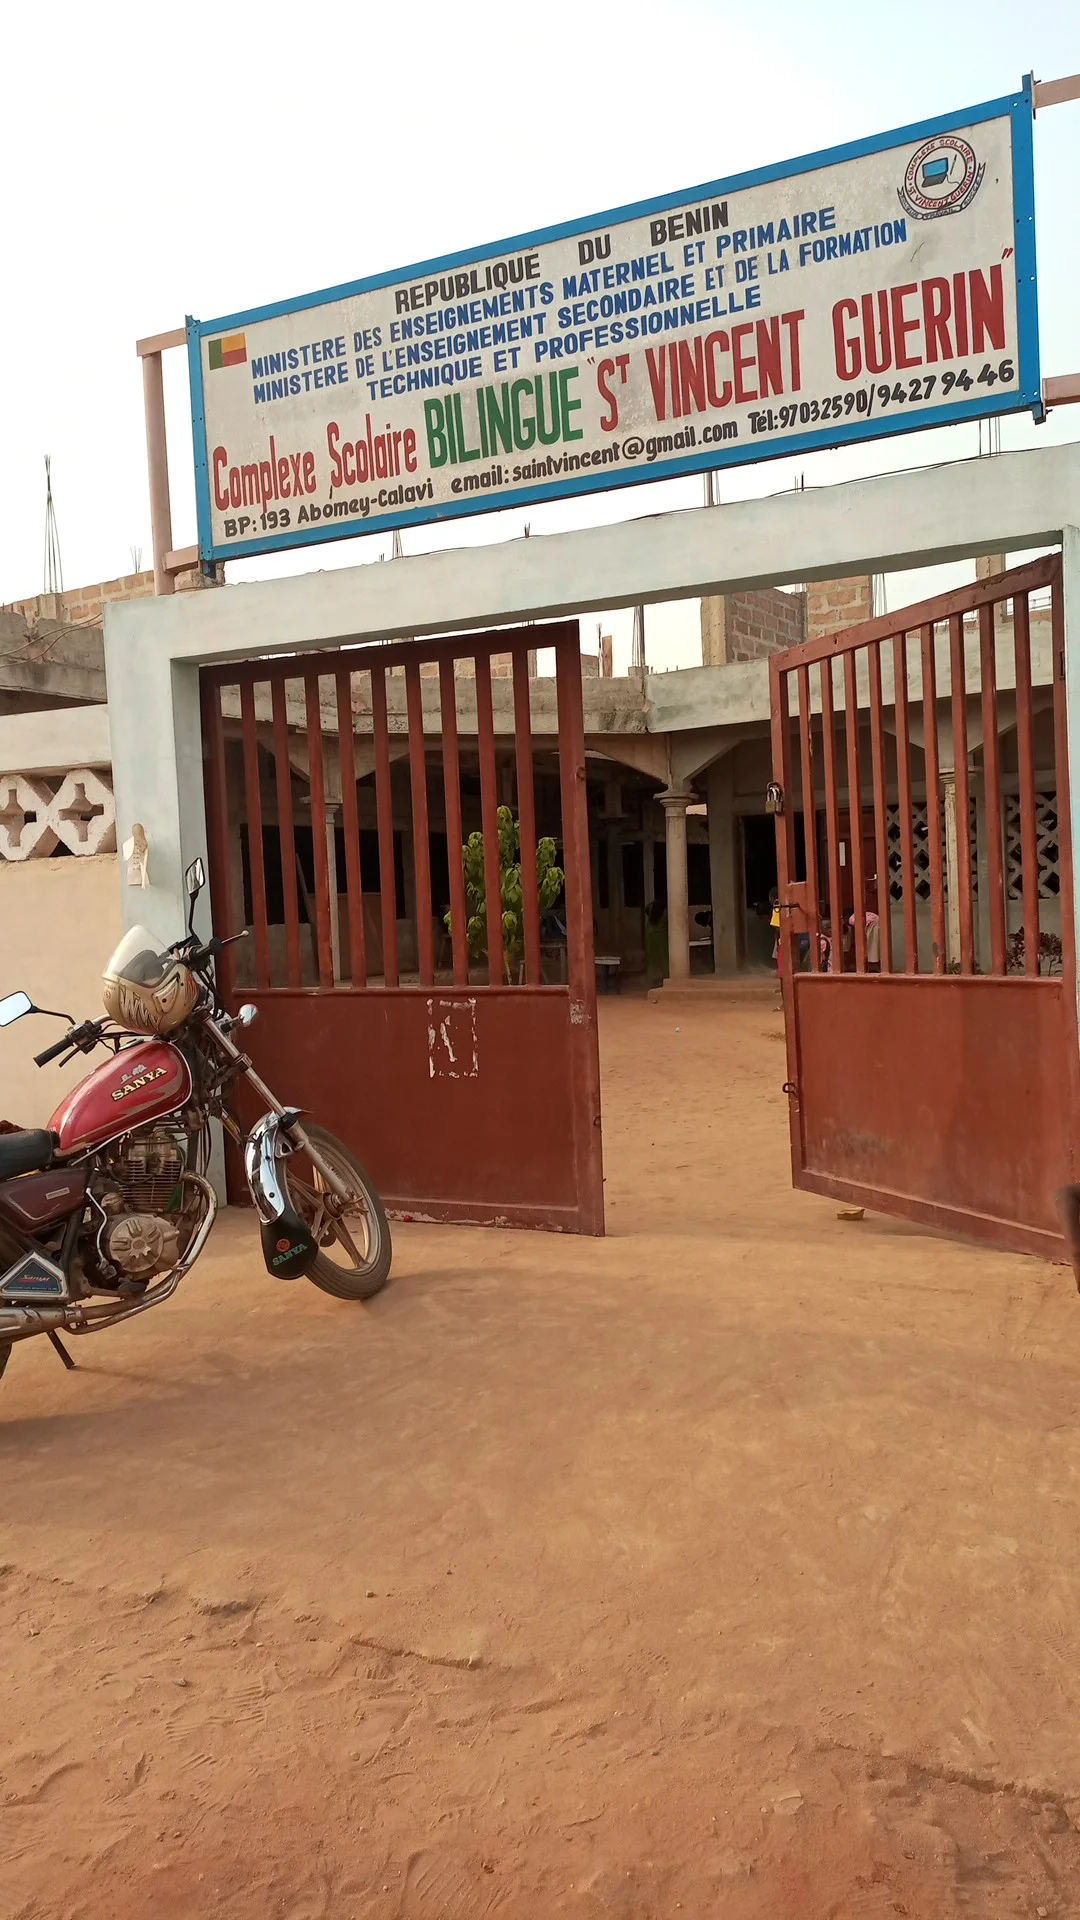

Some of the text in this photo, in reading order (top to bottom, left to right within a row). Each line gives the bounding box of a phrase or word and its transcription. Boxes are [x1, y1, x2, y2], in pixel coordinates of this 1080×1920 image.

[907, 139, 973, 181] COMPLEXE SCOLAIRE
[951, 170, 974, 201] GUERIN
[251, 206, 836, 379] MINISTERE DES ENSEIGNEMENTS MATERNEL ET PRIMAIRE
[395, 201, 729, 315] REPUBLIQUE DU BENIN
[253, 218, 907, 404] MINISTERE DE L'ENSEIGNEMENT SECONDAIRE ET DE LA FORMATION
[366, 285, 761, 401] TECHNIQUE ET PROFESSIONNELLE
[213, 435, 317, 514] Complexe
[327, 413, 418, 488] Scolaire
[423, 366, 584, 469] BILINGUE
[644, 309, 805, 422] VINCENT
[297, 477, 434, 525] Abomey-Calavi
[111, 1067, 168, 1101] SANYA
[272, 1243, 308, 1266] SANYA
